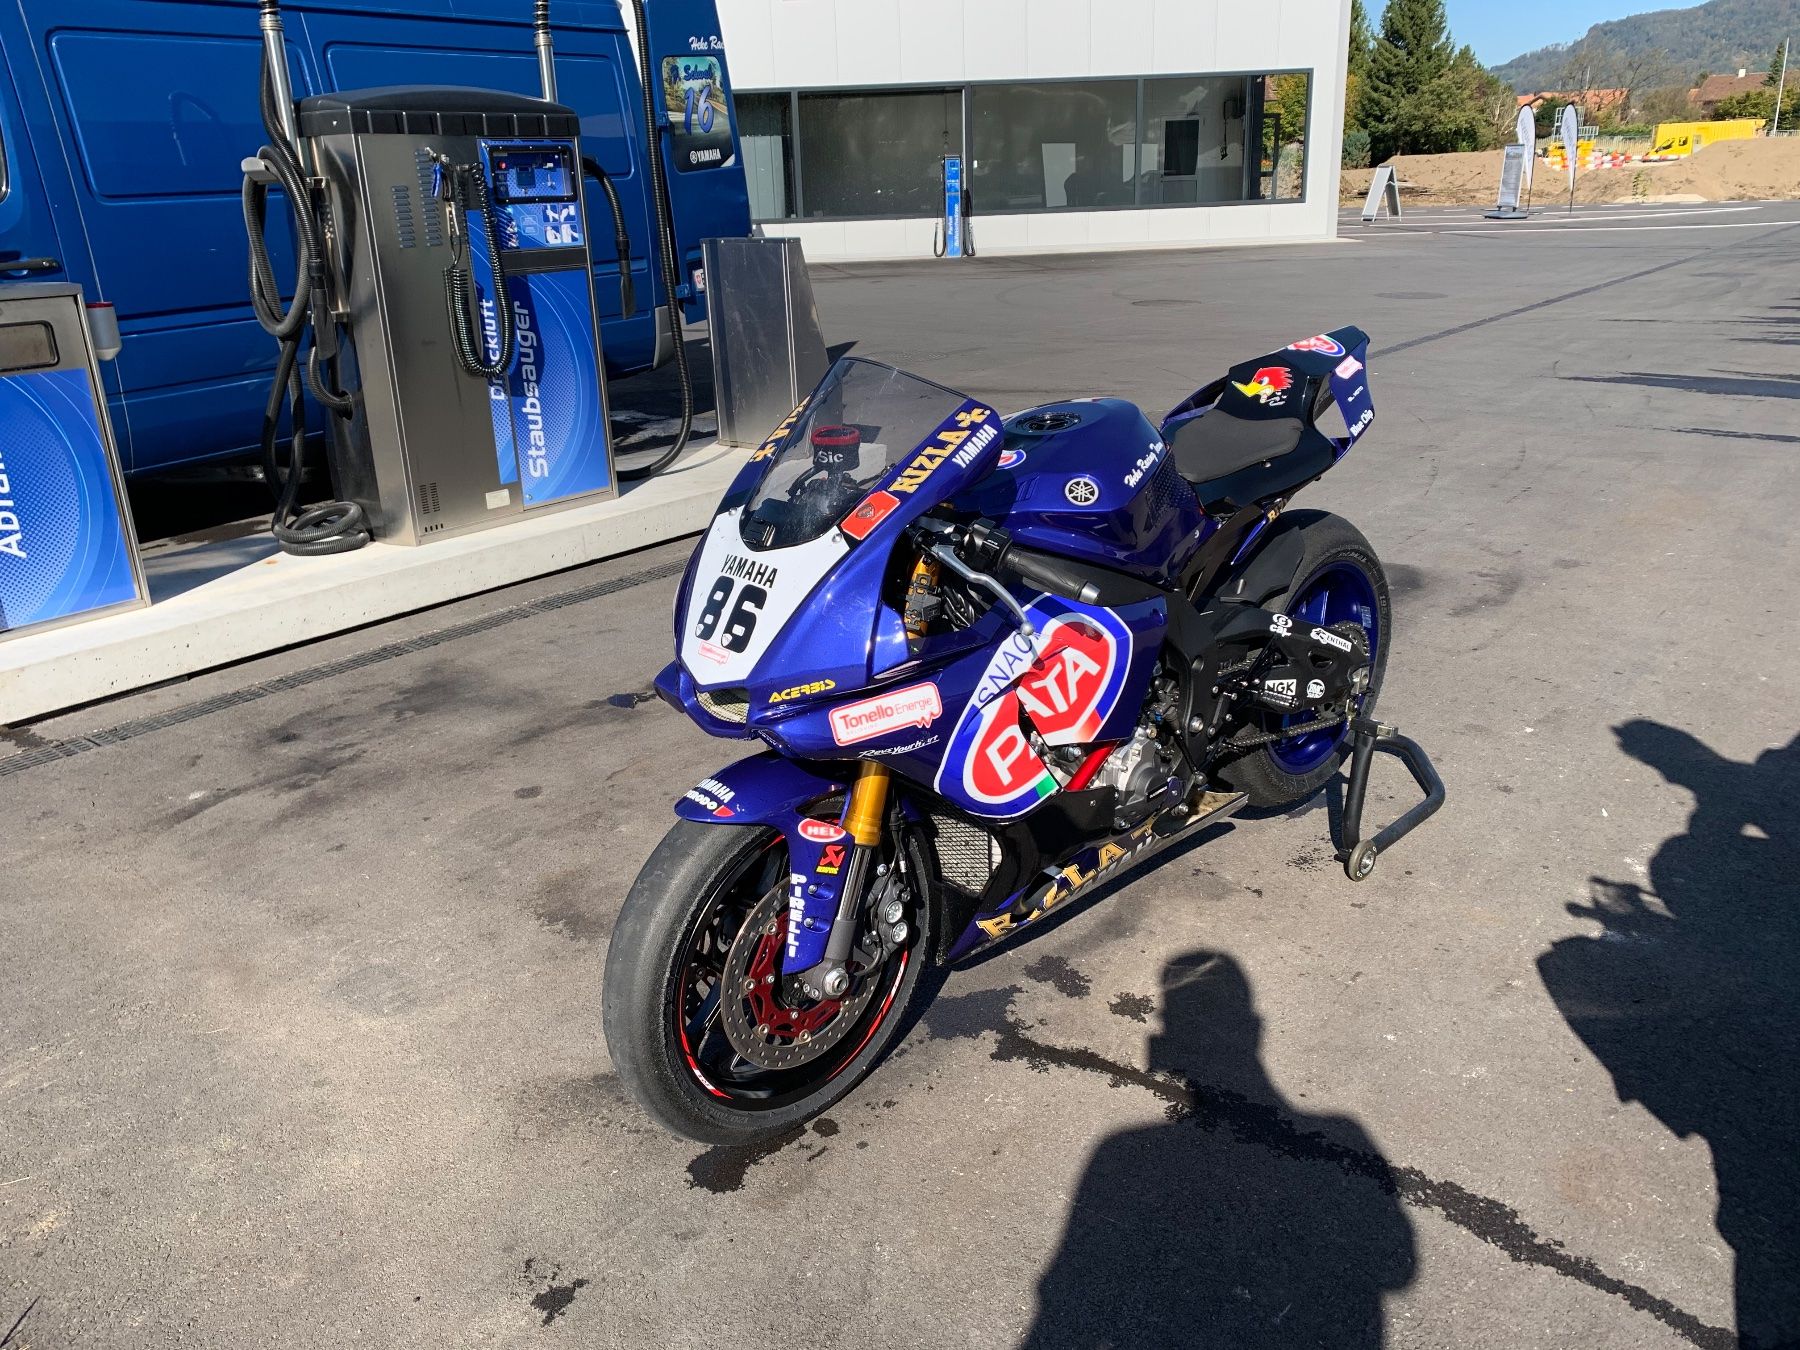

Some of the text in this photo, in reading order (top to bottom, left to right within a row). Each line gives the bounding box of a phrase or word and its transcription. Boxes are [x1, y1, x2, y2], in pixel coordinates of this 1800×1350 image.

[684, 84, 714, 135] 16
[696, 149, 722, 161] YAMAHA
[481, 299, 507, 401] Drckluft
[513, 301, 549, 478] Staubsauger
[951, 423, 998, 468] YAMAHA
[1350, 409, 1374, 437] Blue Chip
[720, 554, 778, 588] YAMAHA
[695, 575, 768, 654] 86
[978, 632, 1041, 704] SNAC
[1264, 681, 1295, 695] NGK
[769, 679, 836, 703] ACERBIS
[839, 705, 894, 730] Tonello
[894, 696, 933, 716] Energie
[985, 646, 1102, 786] PATA
[806, 825, 839, 837] HEL
[787, 872, 807, 958] PIRELLI
